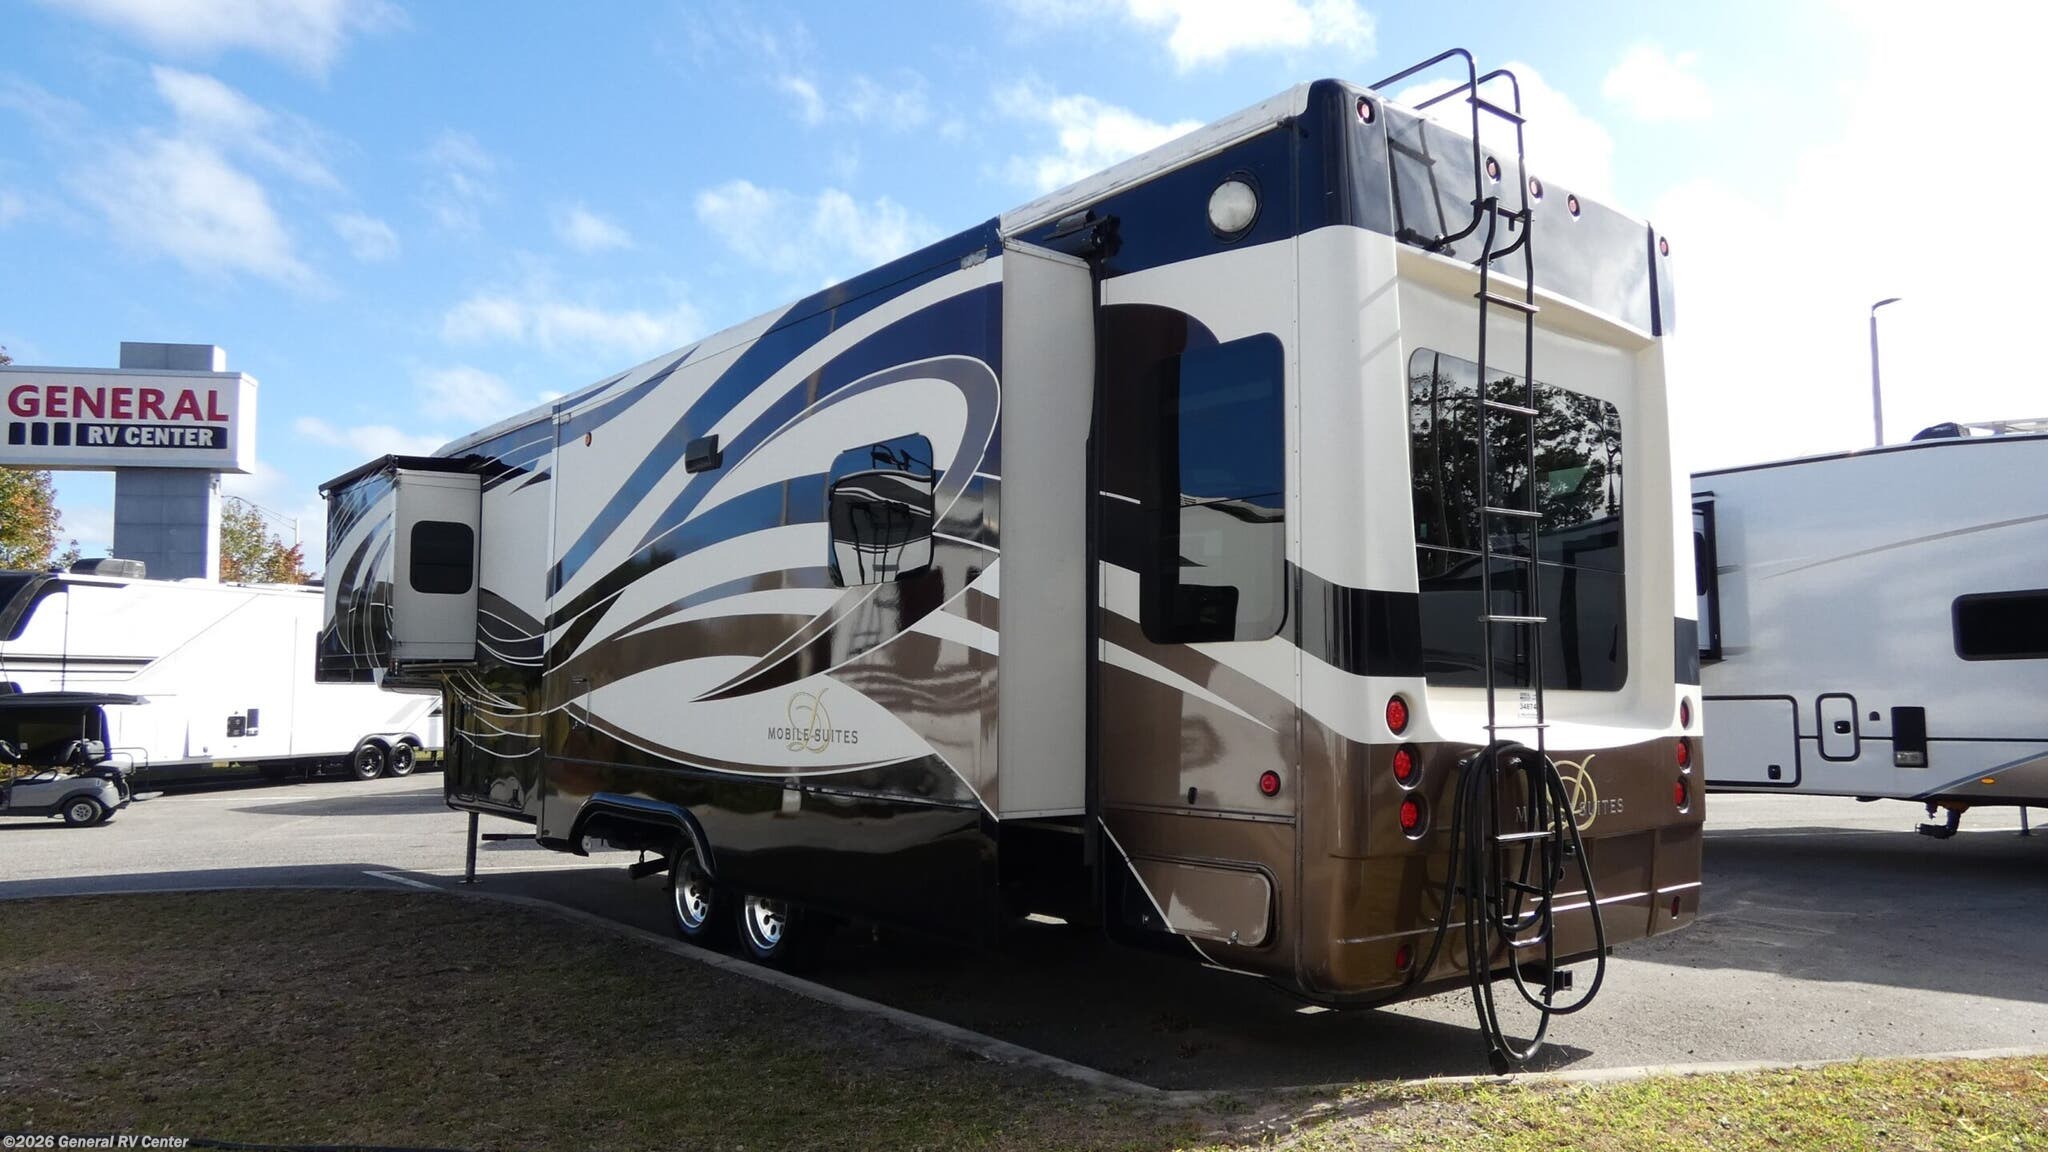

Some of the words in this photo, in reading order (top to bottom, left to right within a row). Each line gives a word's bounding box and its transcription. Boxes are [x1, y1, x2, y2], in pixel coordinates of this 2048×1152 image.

[8, 385, 229, 421] GENERAL
[88, 426, 120, 445] RV
[125, 427, 214, 447] CENTER
[768, 727, 809, 741] MOBILE
[814, 728, 859, 744] SUITES
